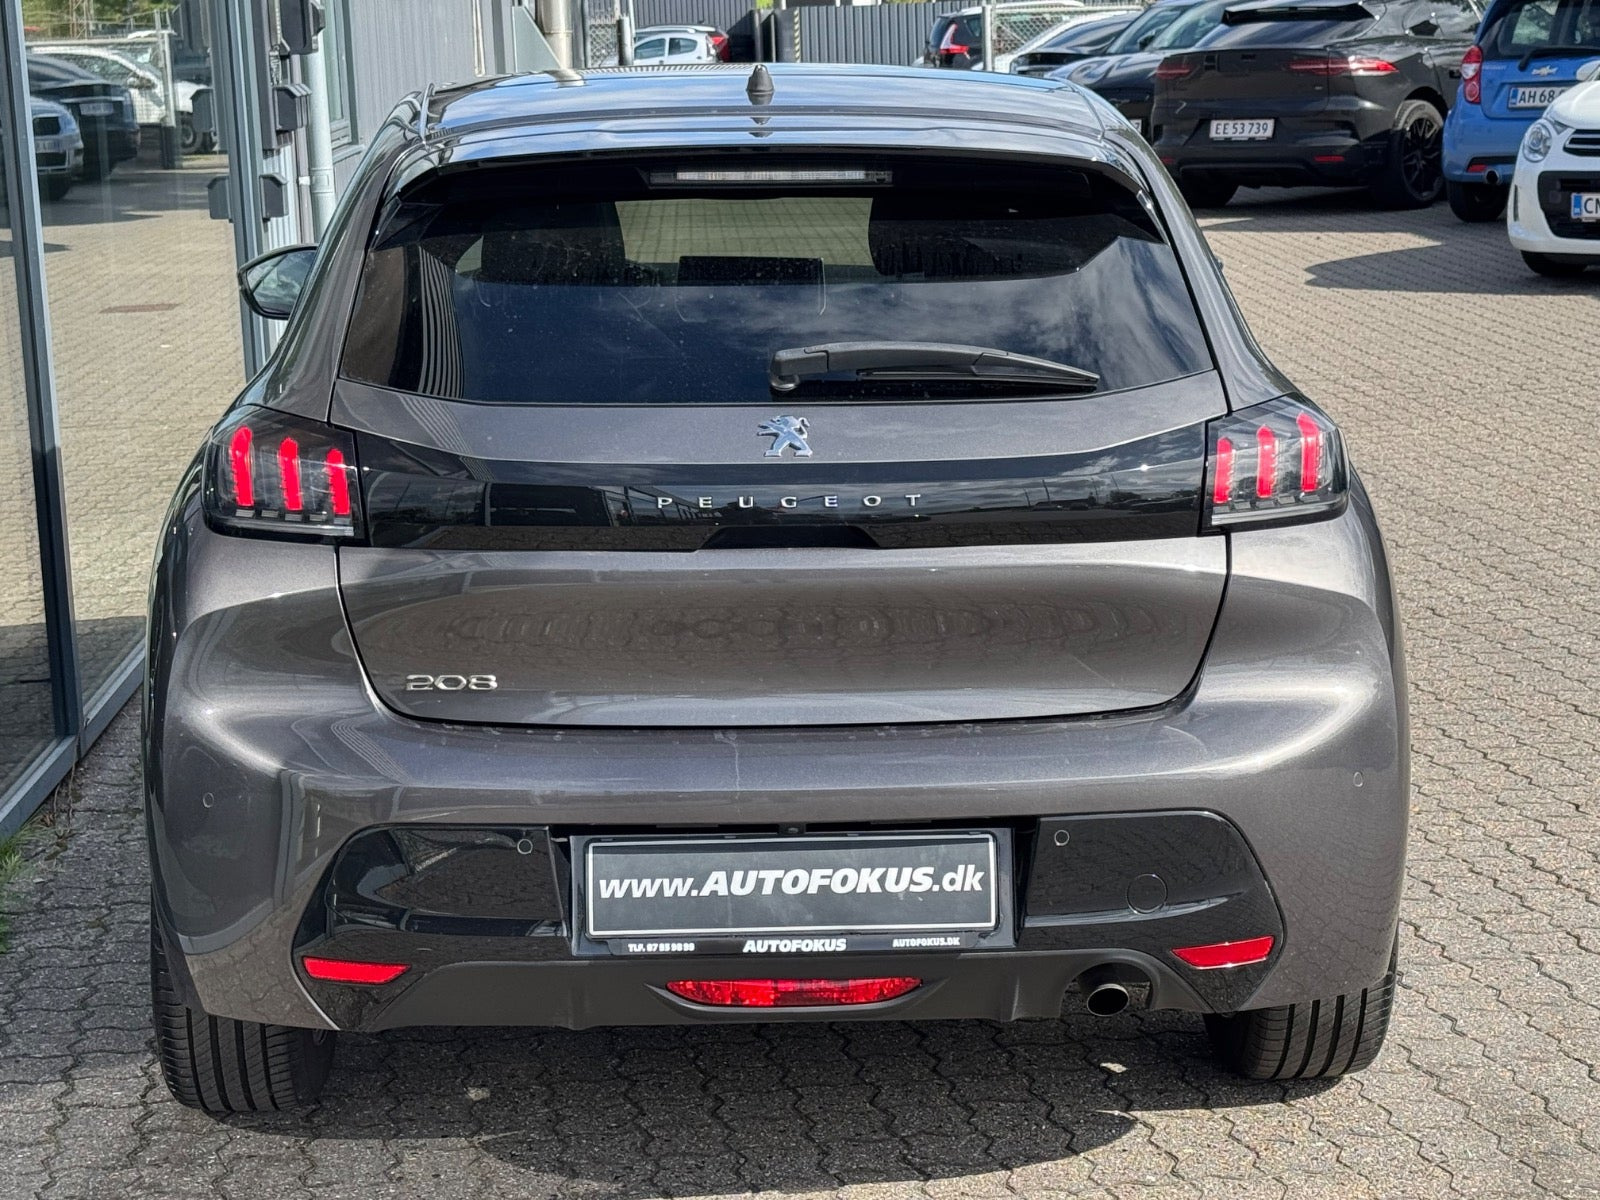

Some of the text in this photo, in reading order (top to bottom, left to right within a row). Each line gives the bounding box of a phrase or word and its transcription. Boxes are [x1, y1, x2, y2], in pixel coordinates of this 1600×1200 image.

[1518, 90, 1537, 104] AH
[1539, 89, 1555, 104] 68
[1215, 122, 1269, 135] EE 53 739
[657, 493, 921, 508] PEUGEOT
[406, 674, 498, 691] 208
[599, 864, 985, 898] www.AUTOFOKUS.dk
[743, 938, 847, 953] AUTOFOKUS
[892, 936, 960, 948] AUTOFOKUS.DK
